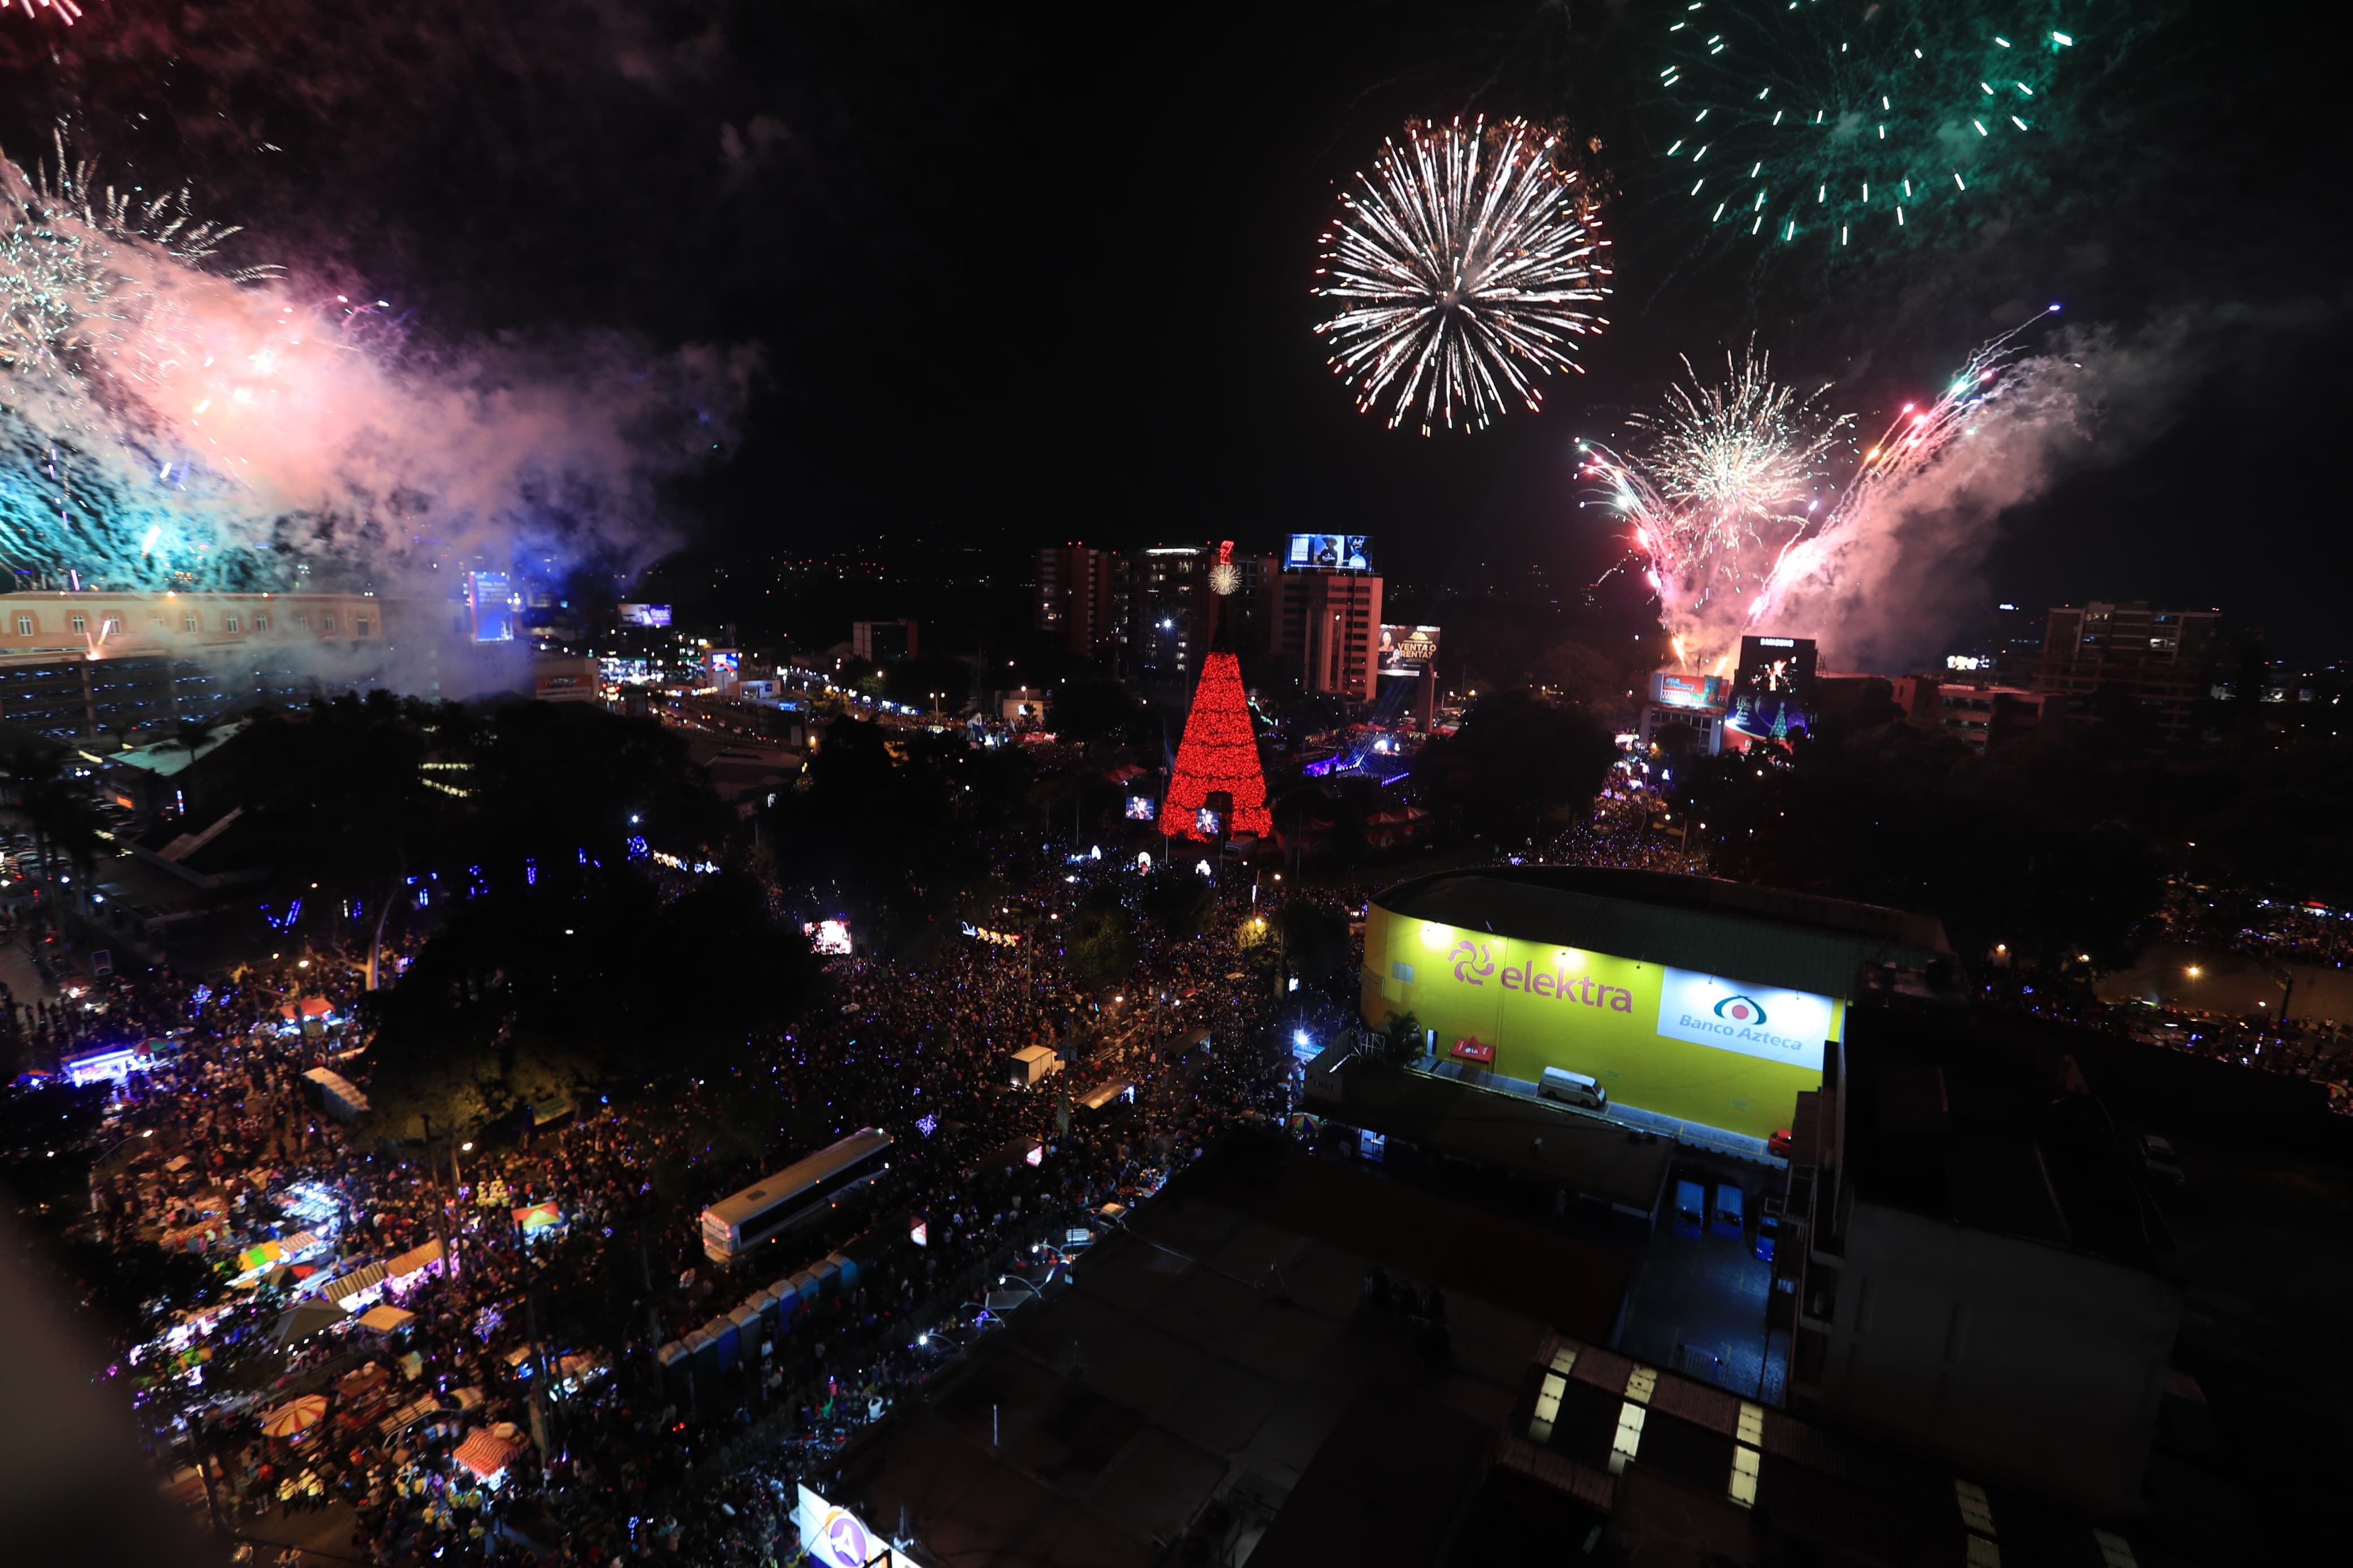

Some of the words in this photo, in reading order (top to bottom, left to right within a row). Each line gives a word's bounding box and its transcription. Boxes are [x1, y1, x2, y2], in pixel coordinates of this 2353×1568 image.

[1398, 643, 1428, 651] VENTA
[1760, 637, 1794, 647] SAMSUNG
[1736, 697, 1747, 707] 18
[1501, 960, 1632, 1013] elektra
[1679, 1014, 1734, 1036] Banco
[1737, 1027, 1802, 1051] Azteca
